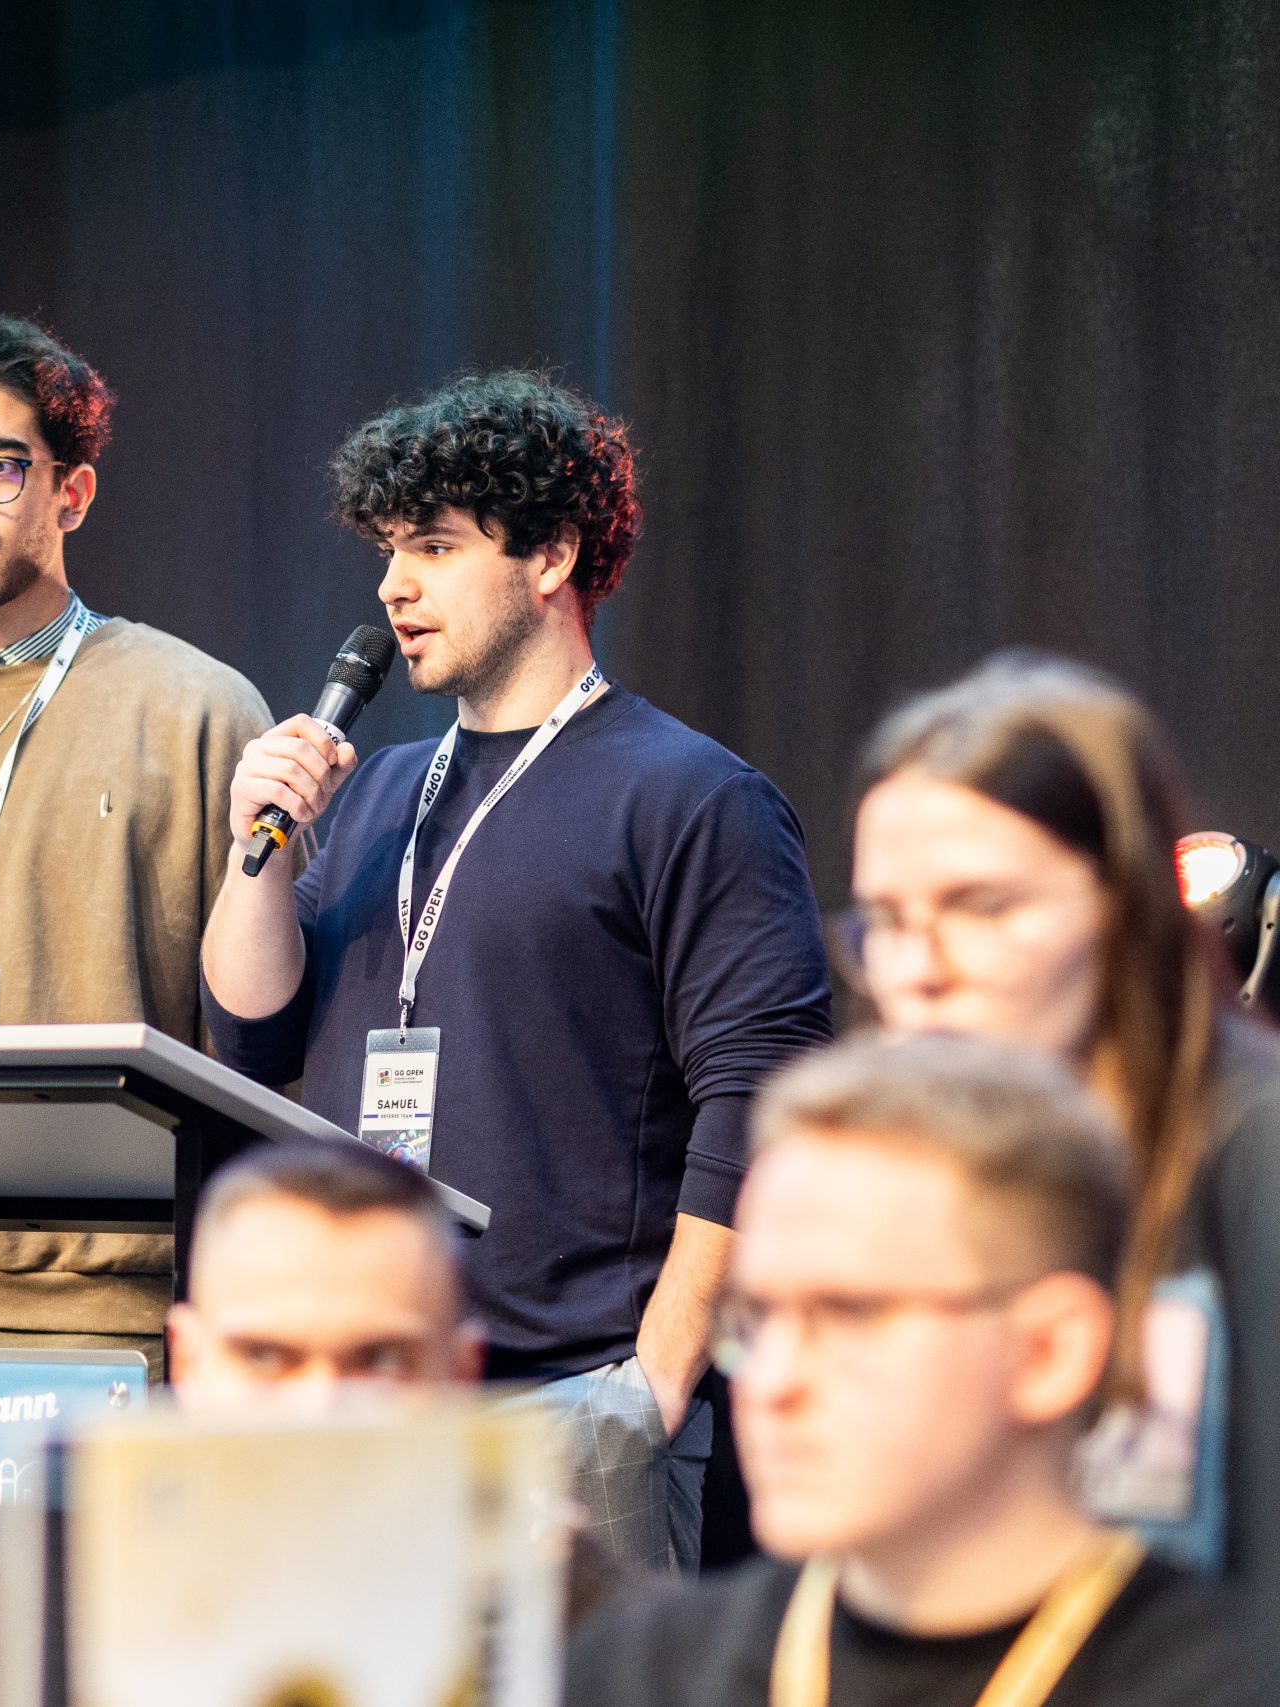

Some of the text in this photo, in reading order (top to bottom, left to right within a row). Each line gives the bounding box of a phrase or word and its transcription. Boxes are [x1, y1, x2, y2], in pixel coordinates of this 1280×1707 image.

[581, 676, 595, 693] GG
[424, 754, 448, 806] GG OPEN
[401, 899, 409, 937] OPEN
[414, 888, 444, 951] GG OPEN
[394, 1069, 424, 1077] GG OPEN
[377, 1099, 419, 1110] SAMUEL
